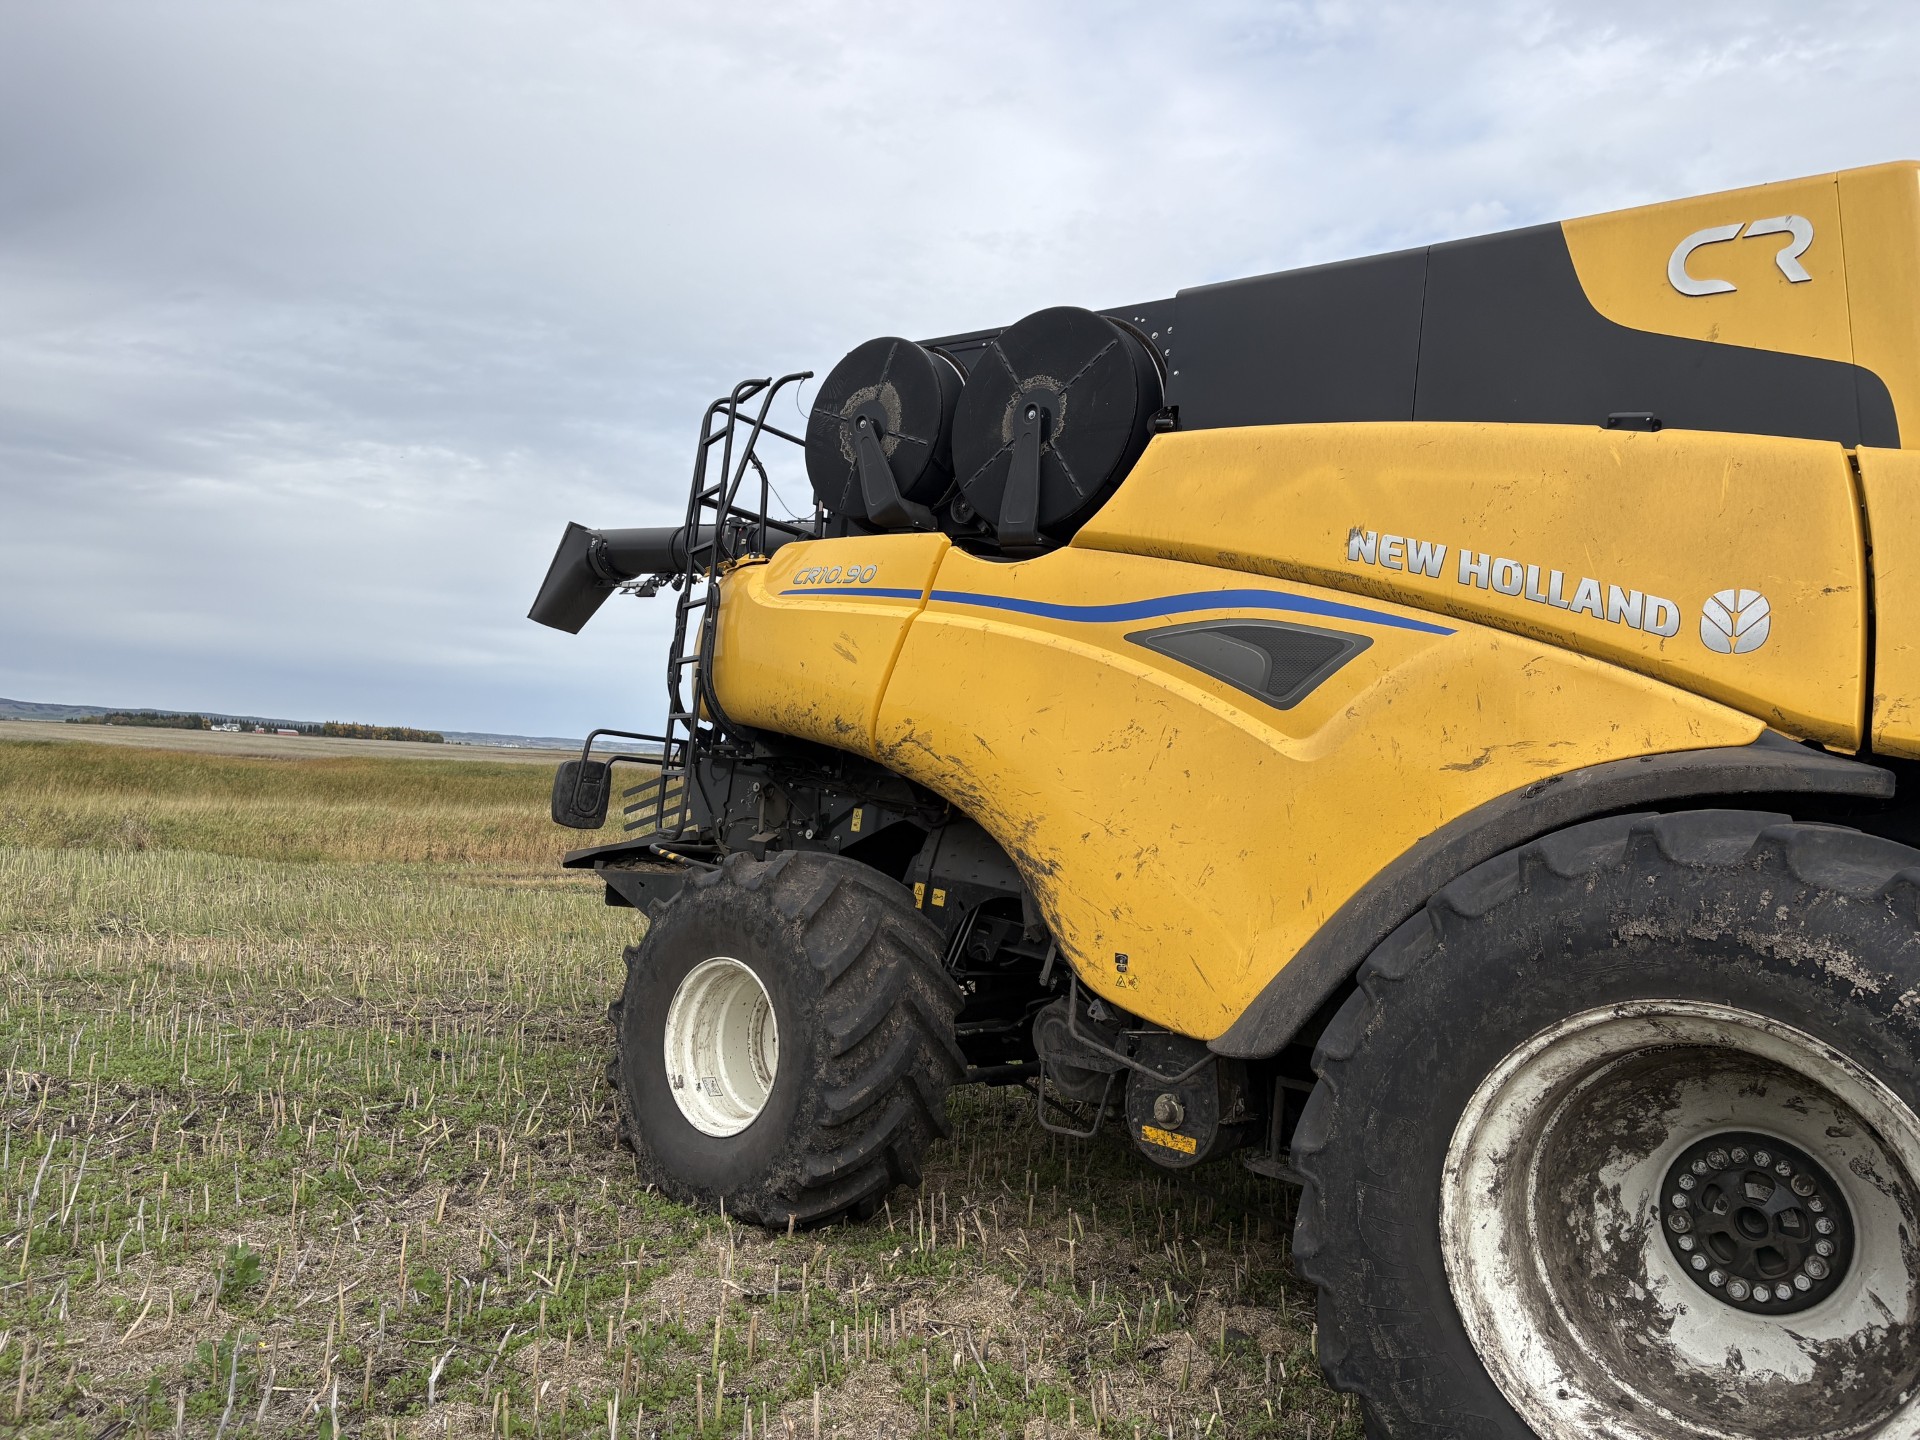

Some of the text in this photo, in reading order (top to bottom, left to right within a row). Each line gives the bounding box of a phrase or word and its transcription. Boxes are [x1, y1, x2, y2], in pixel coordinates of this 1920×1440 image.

[1667, 214, 1814, 298] CR
[792, 564, 878, 585] CR10.90
[1347, 528, 1681, 638] NEW HOLLAND
